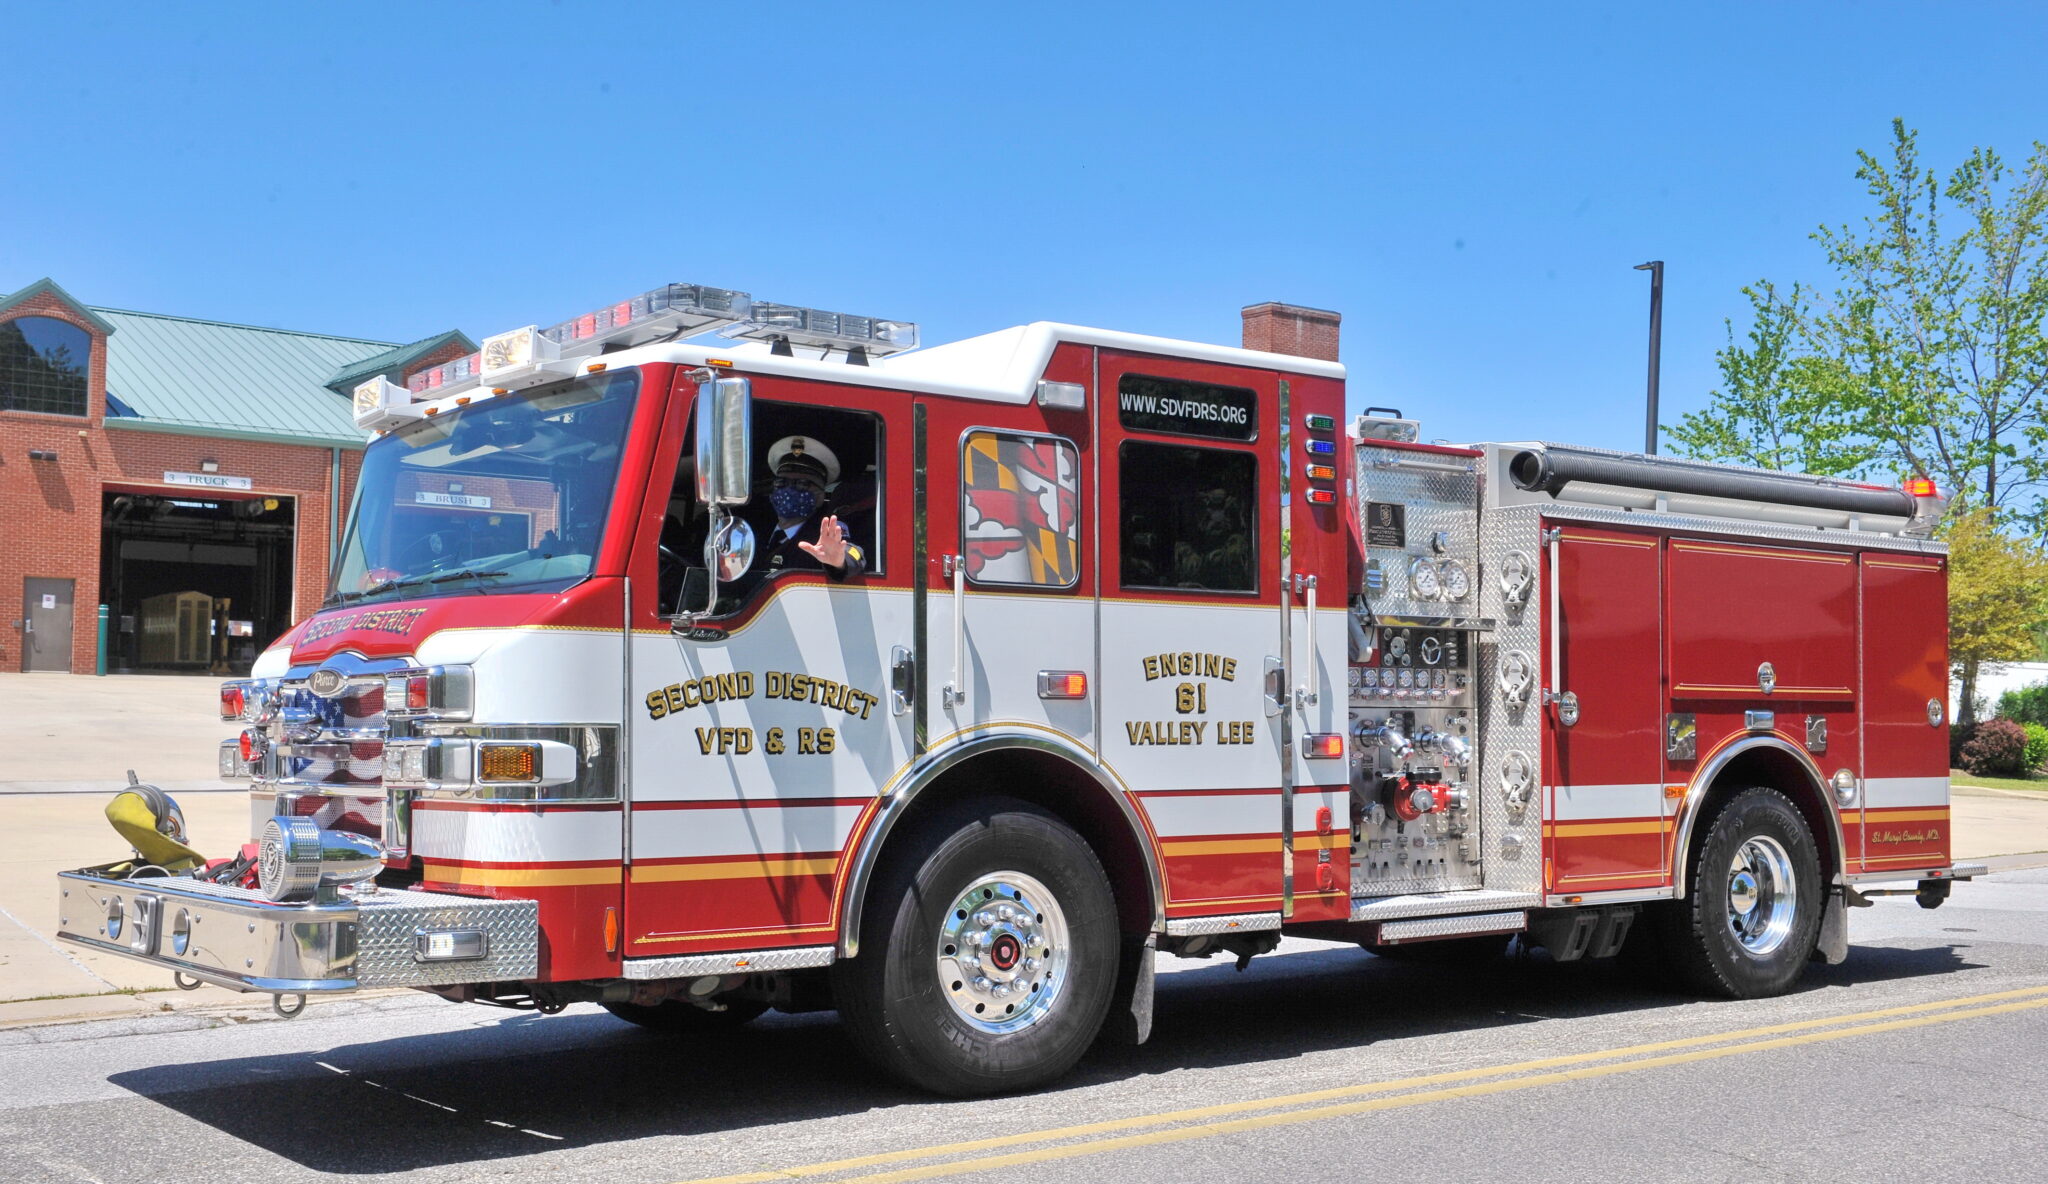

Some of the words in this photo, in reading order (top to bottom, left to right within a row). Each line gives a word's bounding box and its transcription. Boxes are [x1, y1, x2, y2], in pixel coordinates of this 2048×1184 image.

[1120, 393, 1247, 424] WWW.SDVFDRS.ORG
[168, 473, 175, 482] 3
[186, 475, 230, 486] TRUCK
[240, 479, 248, 488] 3
[435, 495, 473, 505] BRUSH
[300, 614, 357, 648] SECOND
[352, 607, 428, 636] DISTRICT
[1143, 652, 1237, 682] ENGINE
[646, 671, 754, 720] SECOND
[765, 671, 878, 720] DISTRICT
[1176, 682, 1207, 714] 61
[695, 726, 753, 755] VFD
[765, 726, 786, 755] &
[798, 726, 836, 755] RS
[1125, 721, 1208, 746] VALLEY
[1217, 721, 1255, 745] LEE
